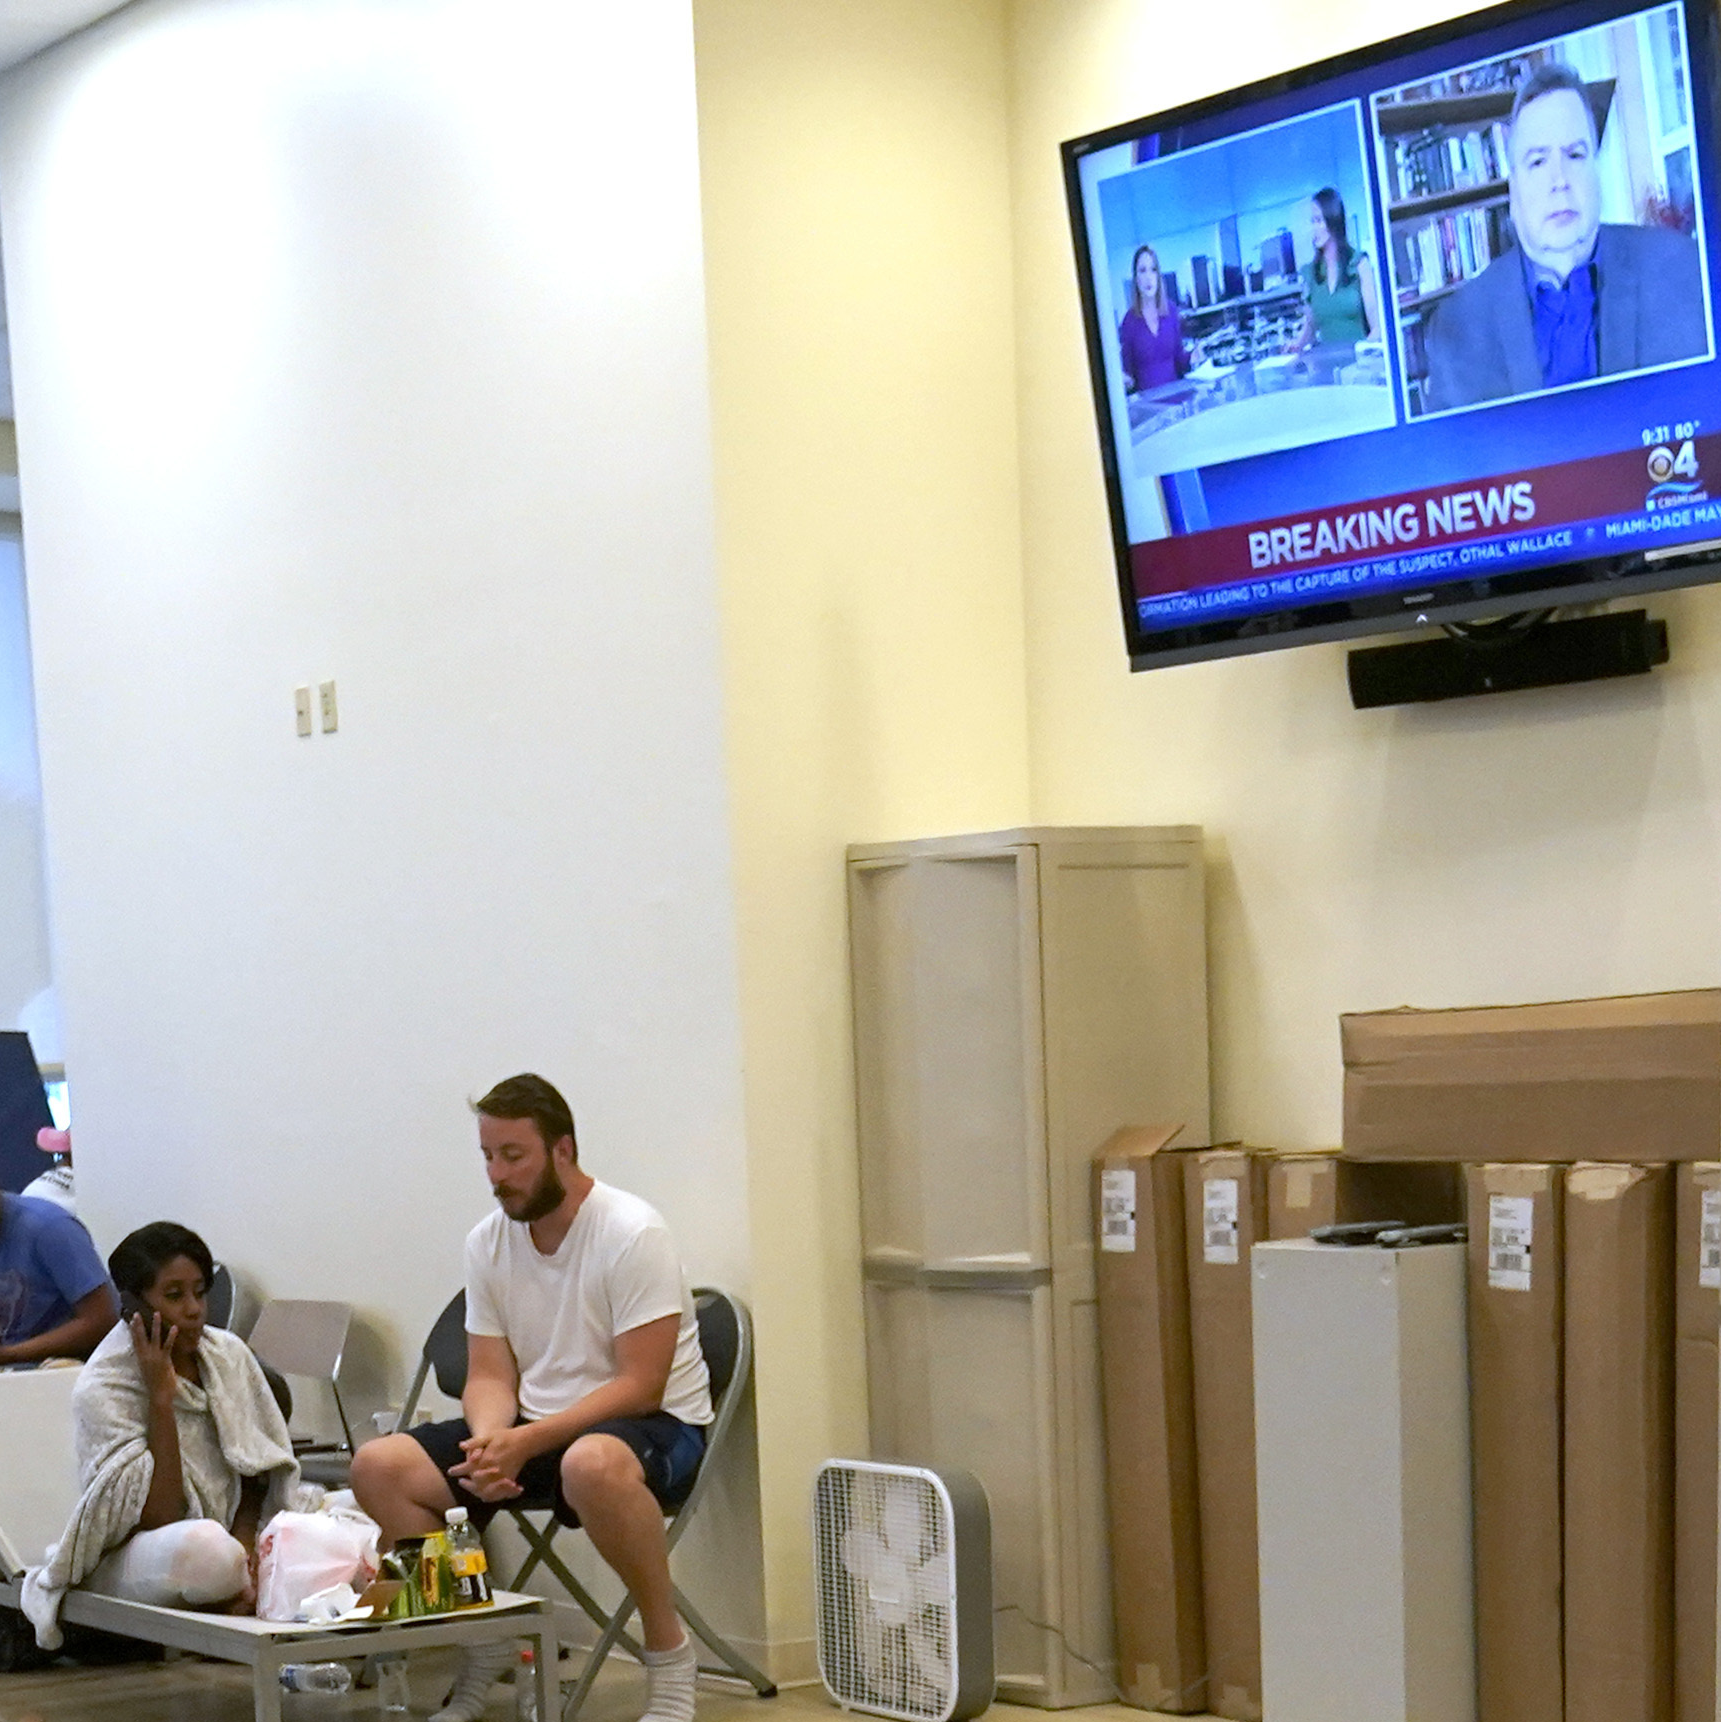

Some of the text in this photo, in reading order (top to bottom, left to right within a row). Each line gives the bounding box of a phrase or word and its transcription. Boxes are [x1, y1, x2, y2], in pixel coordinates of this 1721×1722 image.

[1198, 587, 1250, 608] LEADING
[1250, 584, 1268, 600] TO
[1269, 579, 1294, 595] THE
[1294, 569, 1350, 592] CAPTURE
[1351, 564, 1370, 583] OF
[1371, 559, 1397, 577] THE
[1505, 528, 1573, 556] WALLACE
[1605, 507, 1693, 539] MIAMI-DADE
[1248, 481, 1536, 569] BREAKING NEWS
